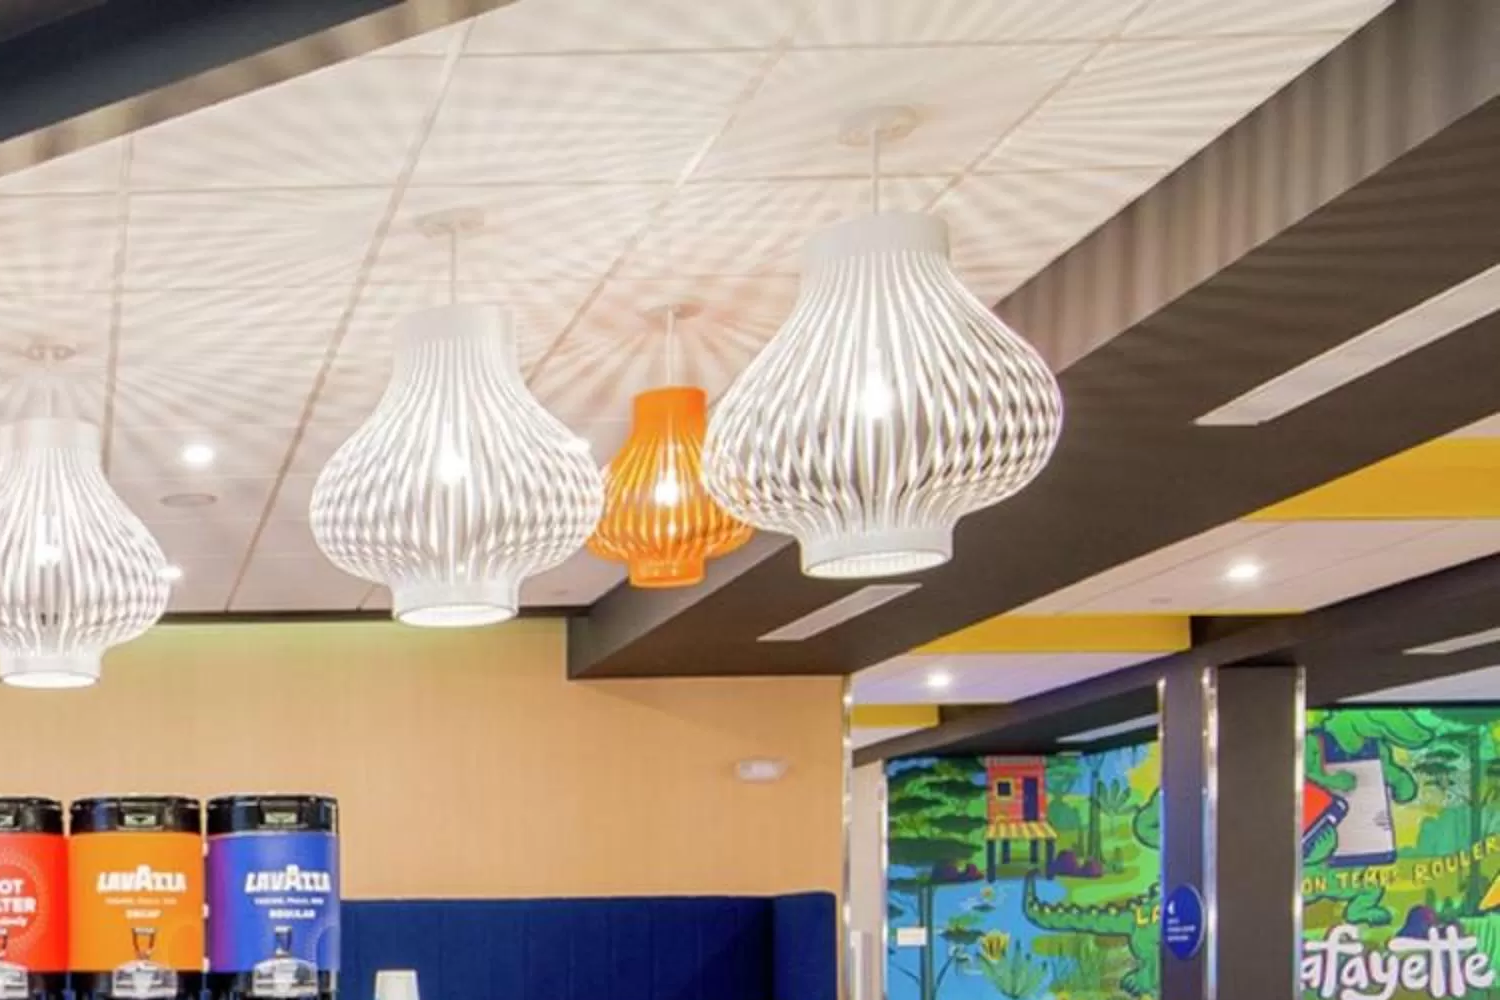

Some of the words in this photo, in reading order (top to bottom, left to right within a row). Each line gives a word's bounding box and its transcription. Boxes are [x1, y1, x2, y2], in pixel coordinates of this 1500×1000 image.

[96, 864, 187, 893] LAVAZZA
[244, 863, 332, 893] LAVAZZA
[1300, 875, 1328, 894] ON
